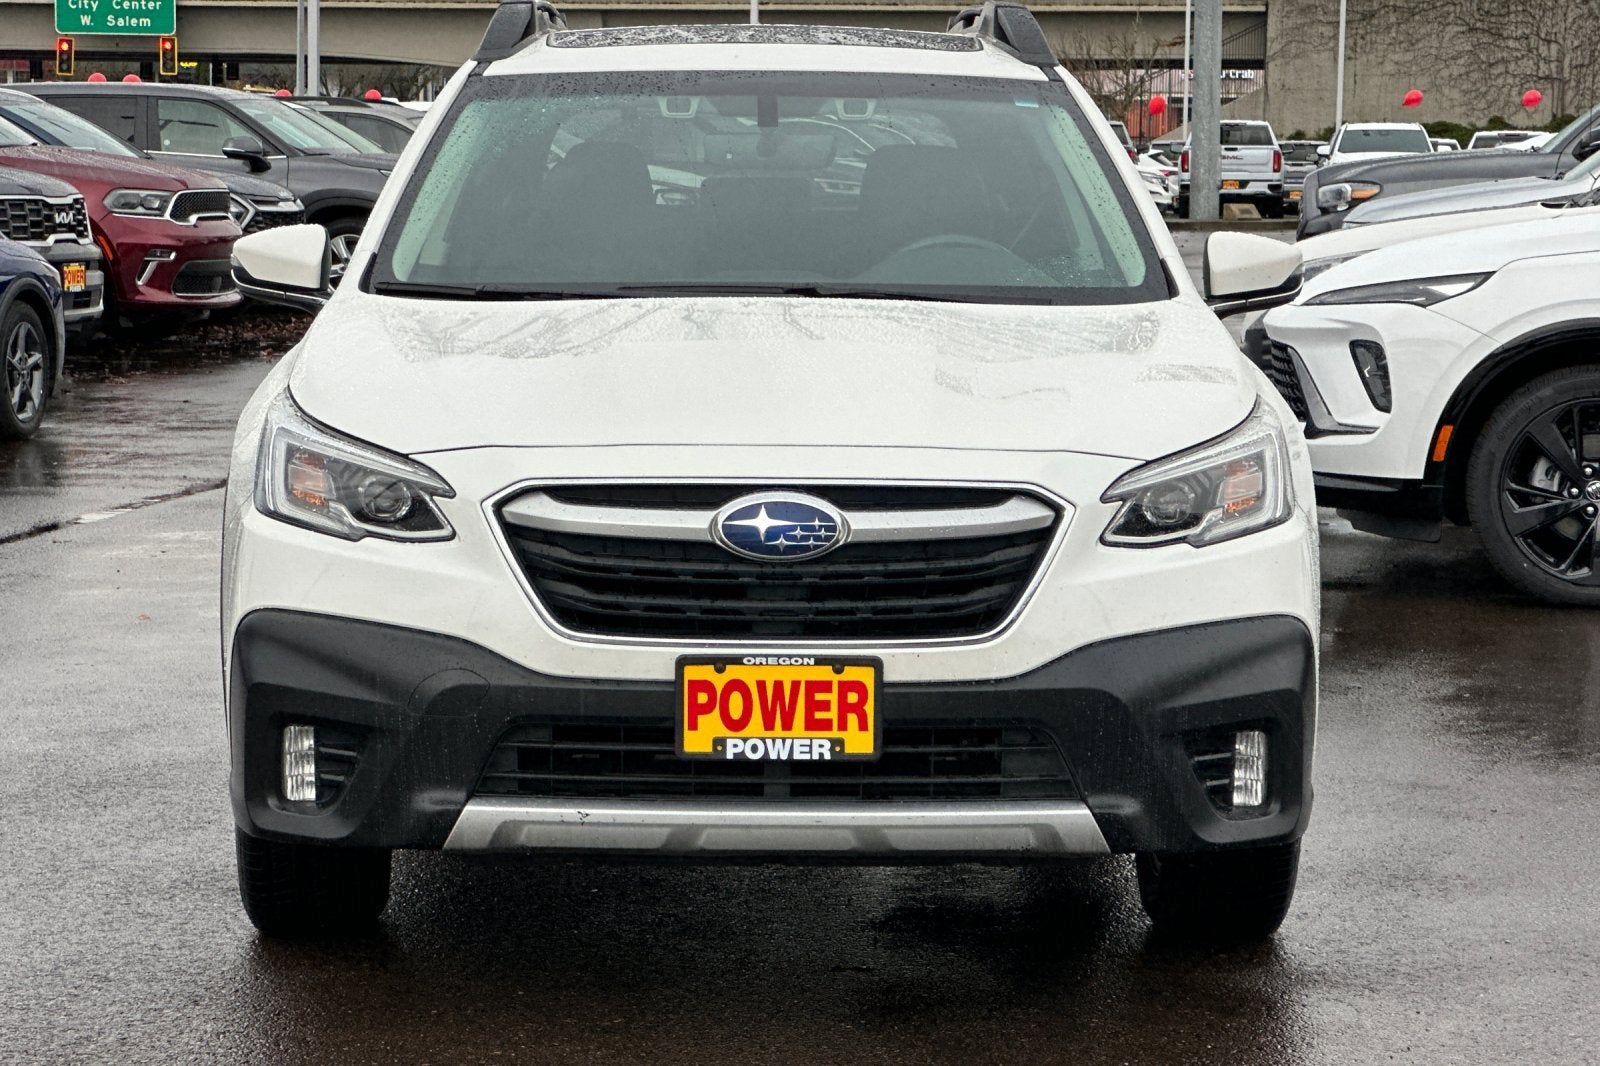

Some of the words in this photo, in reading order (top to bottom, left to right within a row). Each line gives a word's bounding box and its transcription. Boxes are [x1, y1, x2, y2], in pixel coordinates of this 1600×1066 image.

[68, 0, 99, 12] City
[112, 0, 162, 10] Center
[80, 14, 95, 26] W.
[106, 14, 151, 27] Salem
[64, 269, 84, 284] POWER
[742, 656, 815, 666] OREGON
[687, 678, 869, 732] POWER
[726, 738, 831, 760] POWER
